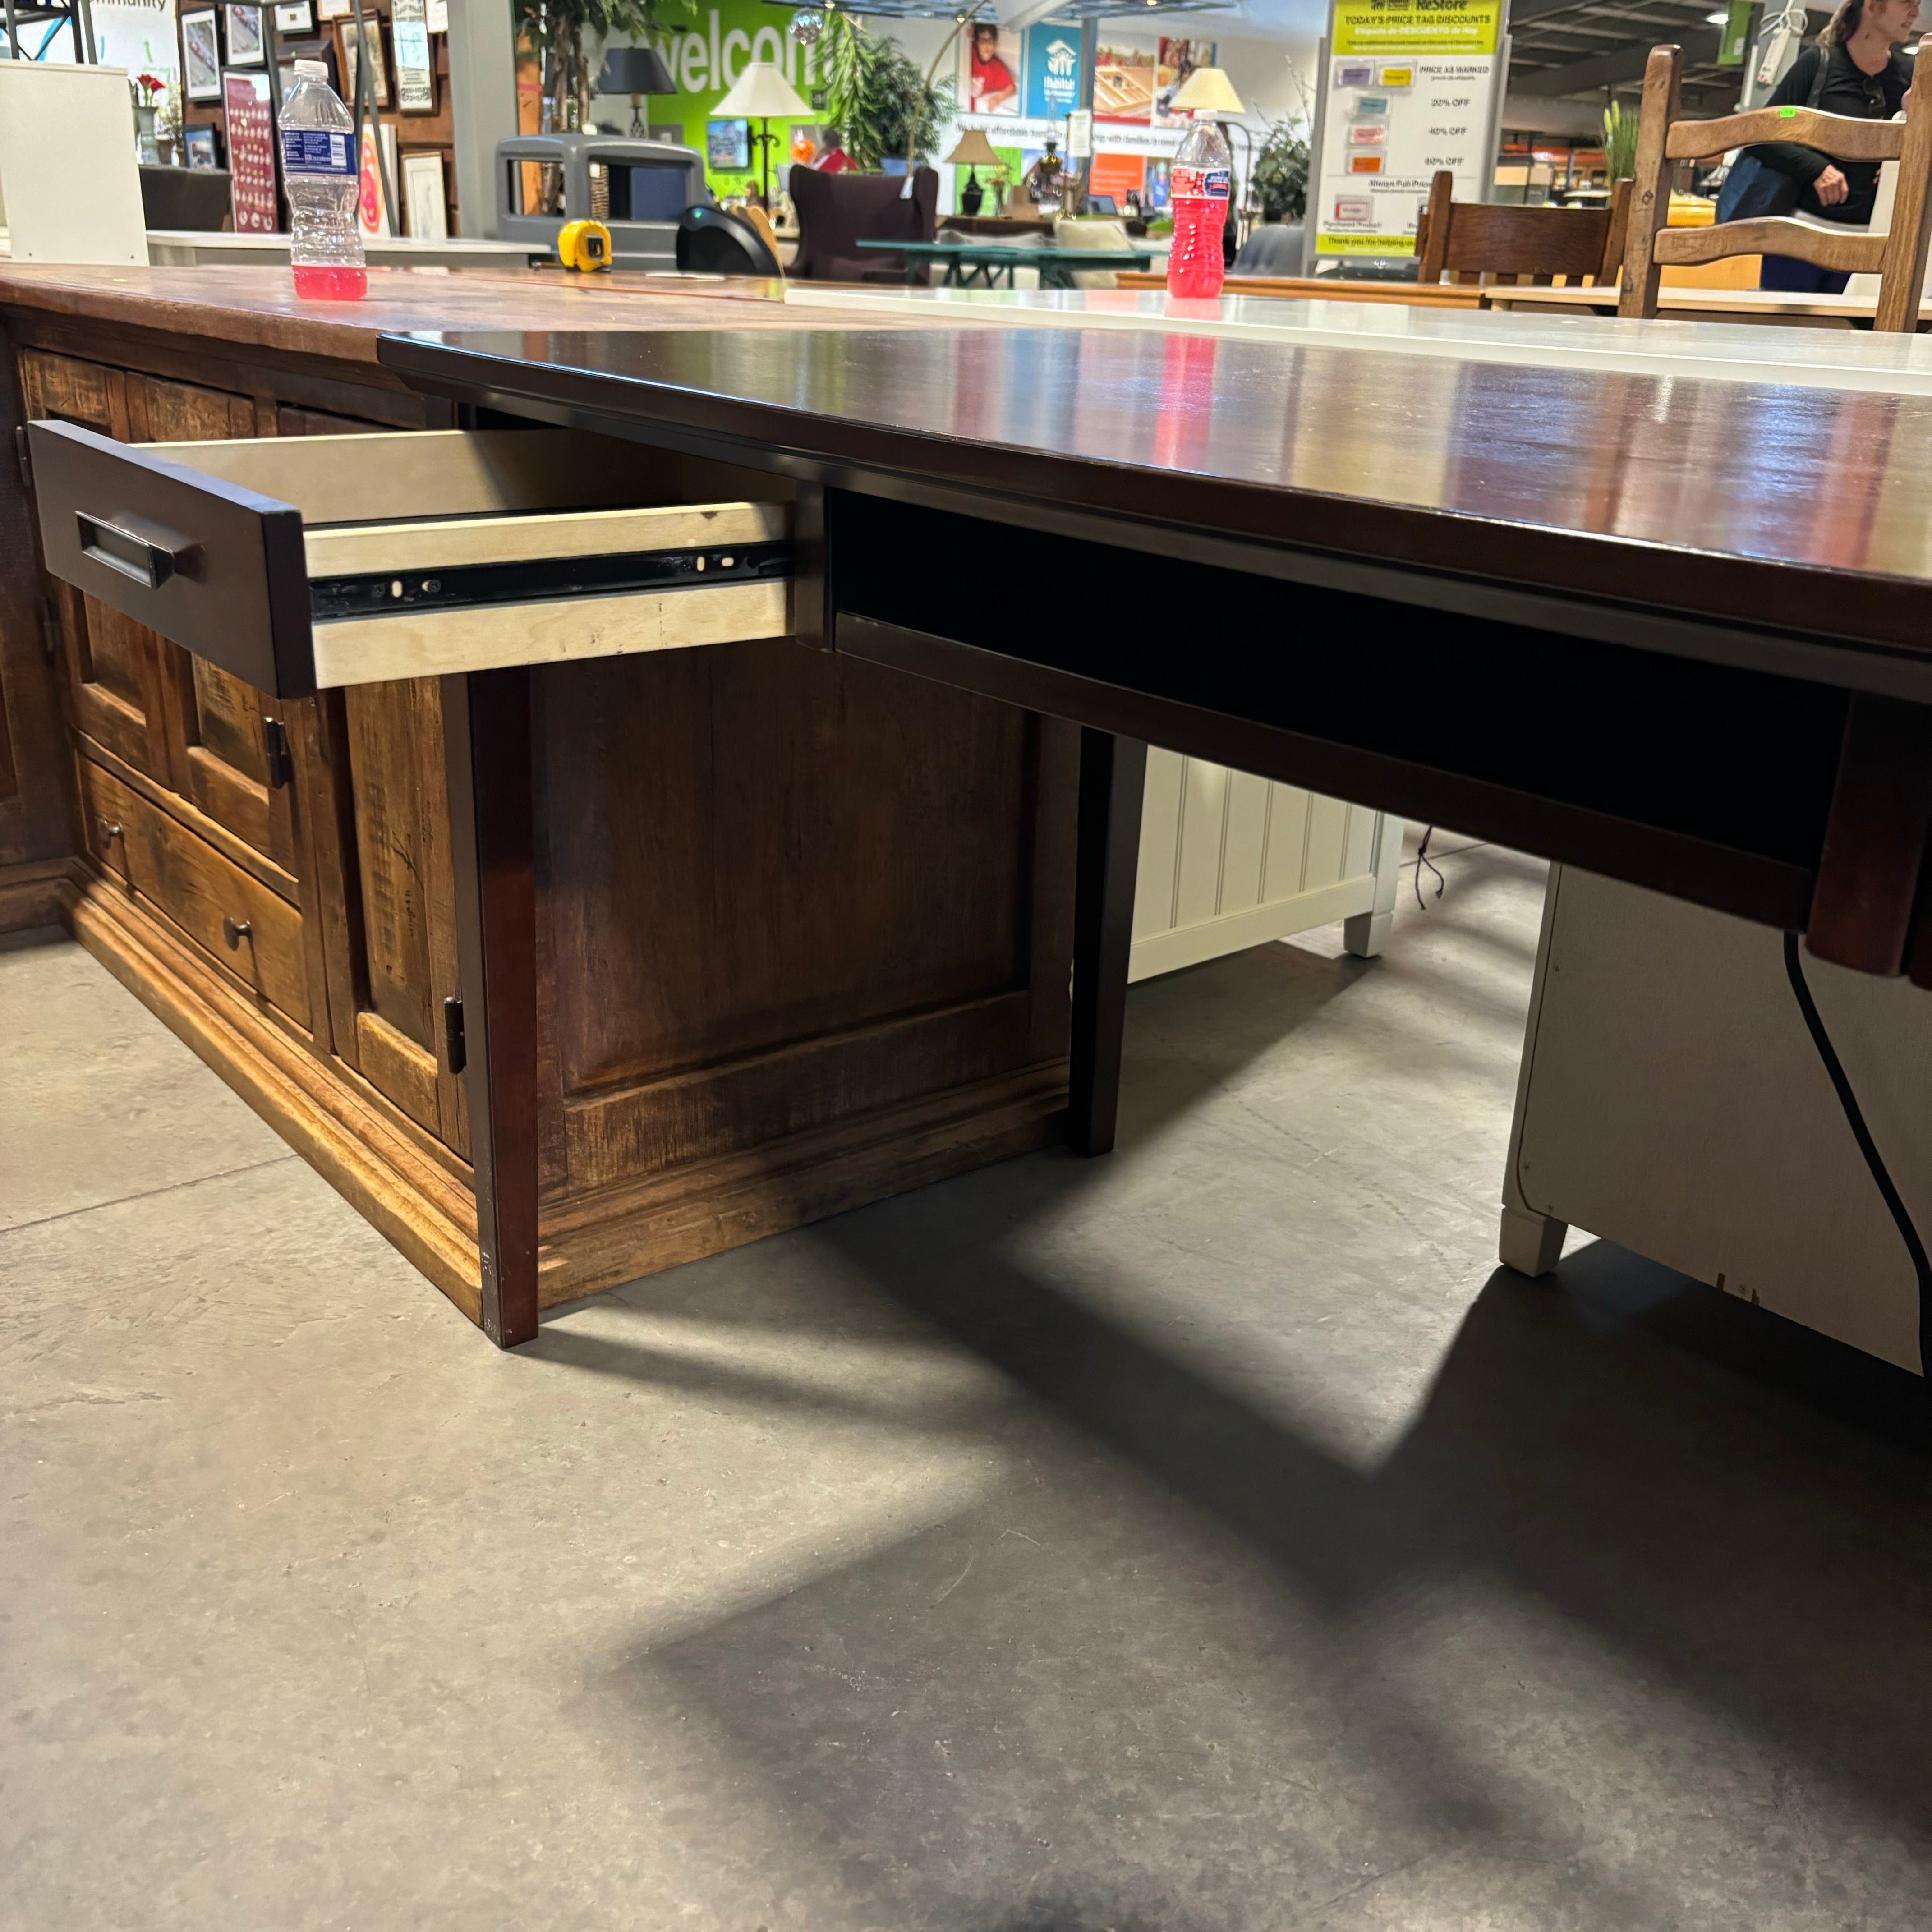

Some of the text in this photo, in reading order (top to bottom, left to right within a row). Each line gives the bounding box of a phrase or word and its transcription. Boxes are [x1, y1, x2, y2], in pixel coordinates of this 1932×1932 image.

[1345, 15, 1491, 24] TODAY'S PRICE TAG DISCOUNTS
[1431, 98, 1471, 106] 20% OFF
[1449, 126, 1468, 135] OFF
[1445, 156, 1464, 165] OFF
[1369, 179, 1395, 188] Always
